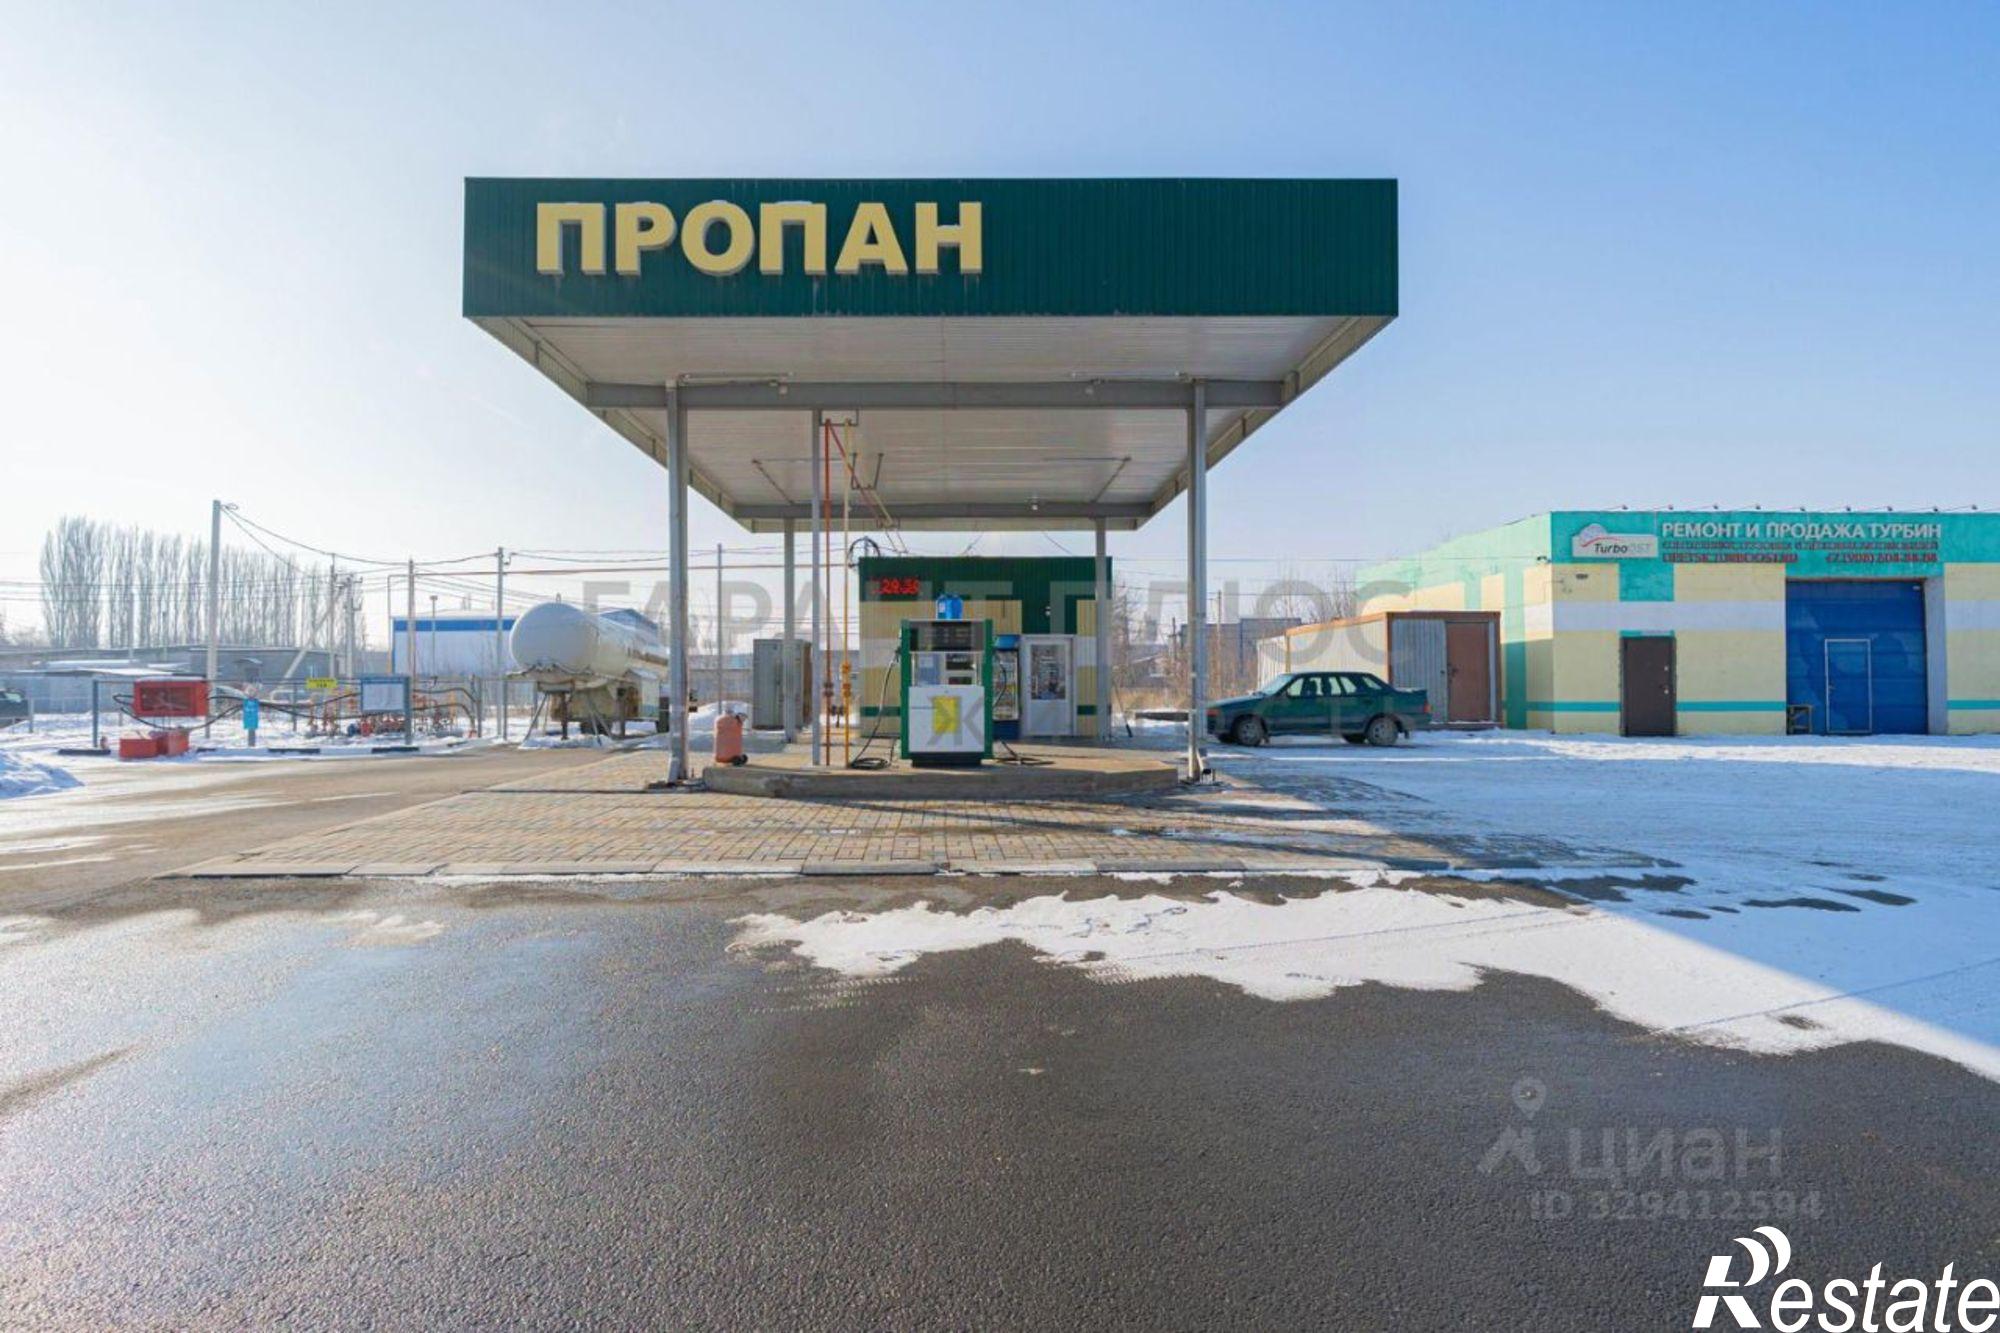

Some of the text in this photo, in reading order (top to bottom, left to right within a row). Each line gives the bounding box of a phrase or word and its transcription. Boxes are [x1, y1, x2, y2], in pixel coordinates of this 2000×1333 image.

[537, 200, 982, 275] ПРОПАН
[1662, 522, 1941, 540] РЕМОНТ И ПРОДАЖА ТУРБИН
